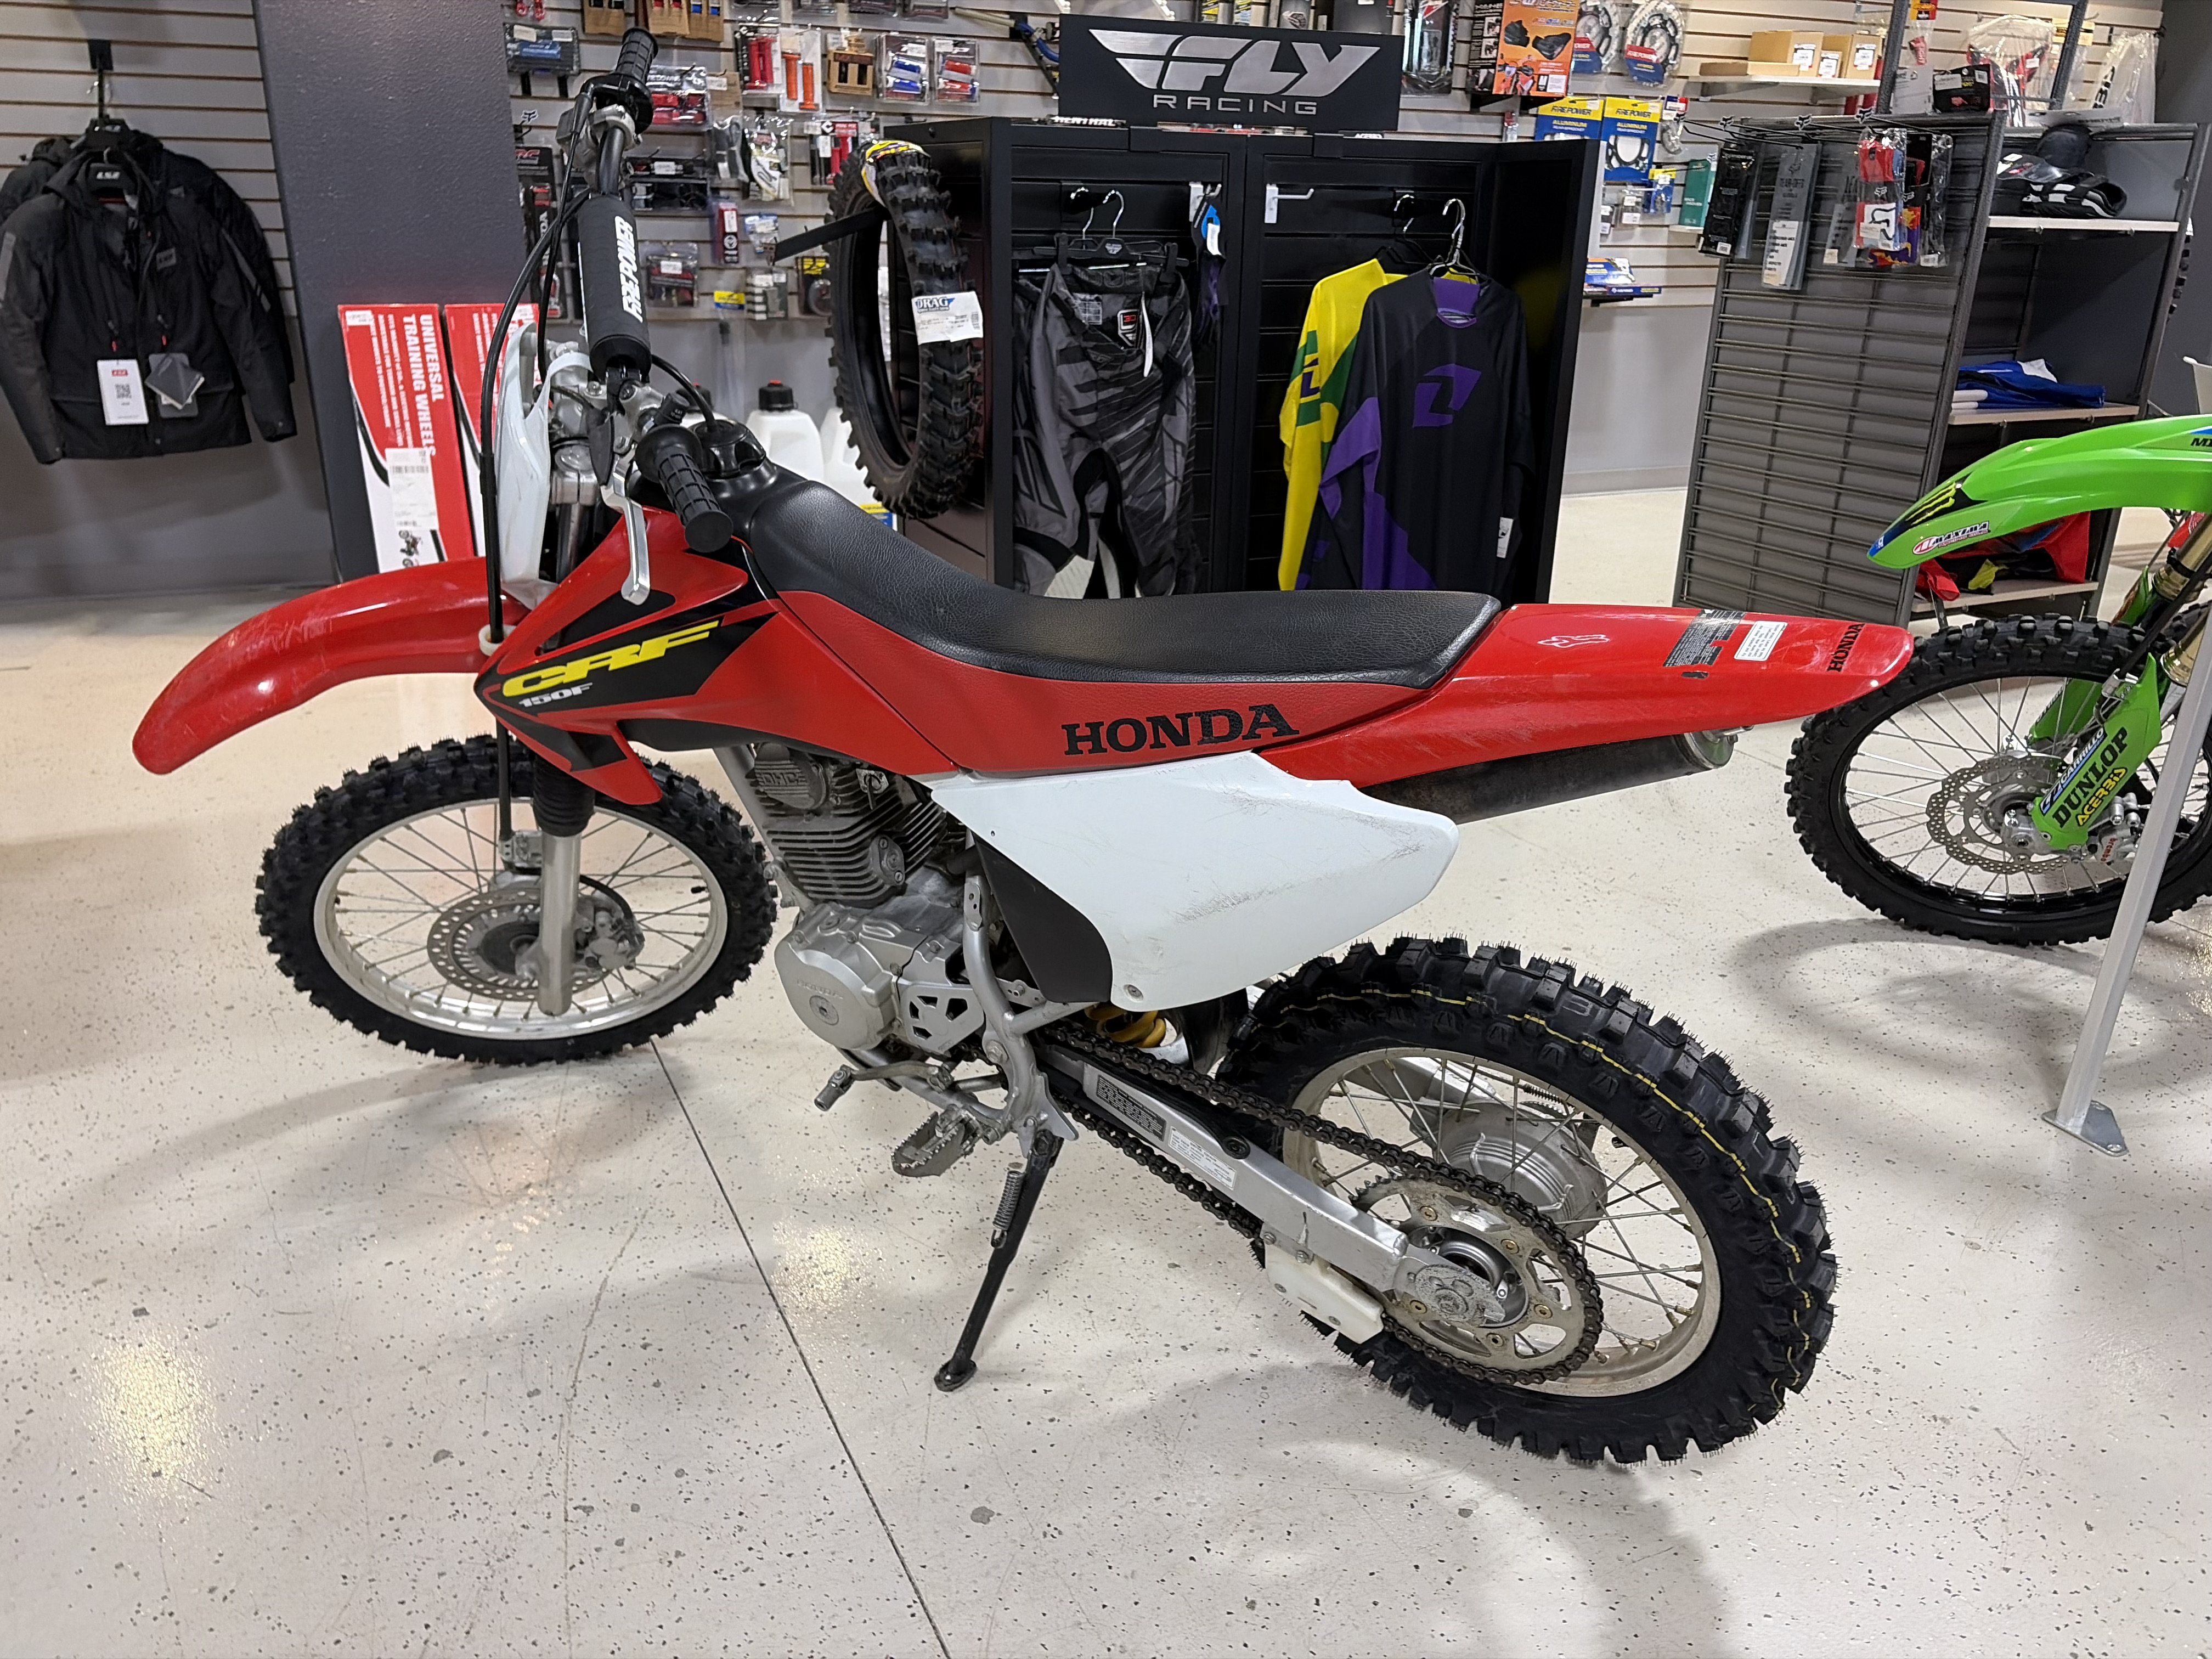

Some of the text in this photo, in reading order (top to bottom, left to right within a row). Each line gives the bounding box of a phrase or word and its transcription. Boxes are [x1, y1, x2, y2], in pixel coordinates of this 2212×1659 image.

[1159, 35, 1381, 97] FLY
[1153, 94, 1317, 115] RACING
[917, 296, 949, 308] DRAG
[403, 314, 436, 456] TRAINING WHEELS
[420, 314, 444, 402] UNIVERSAL
[1933, 521, 1989, 545] MAXIMA
[503, 620, 719, 697] CRF
[1826, 623, 1866, 673] HONDA
[519, 682, 593, 707] 150F
[1061, 704, 1300, 755] HONDA
[2061, 727, 2104, 785] CARRILLO
[2052, 726, 2128, 828] DUNLOP
